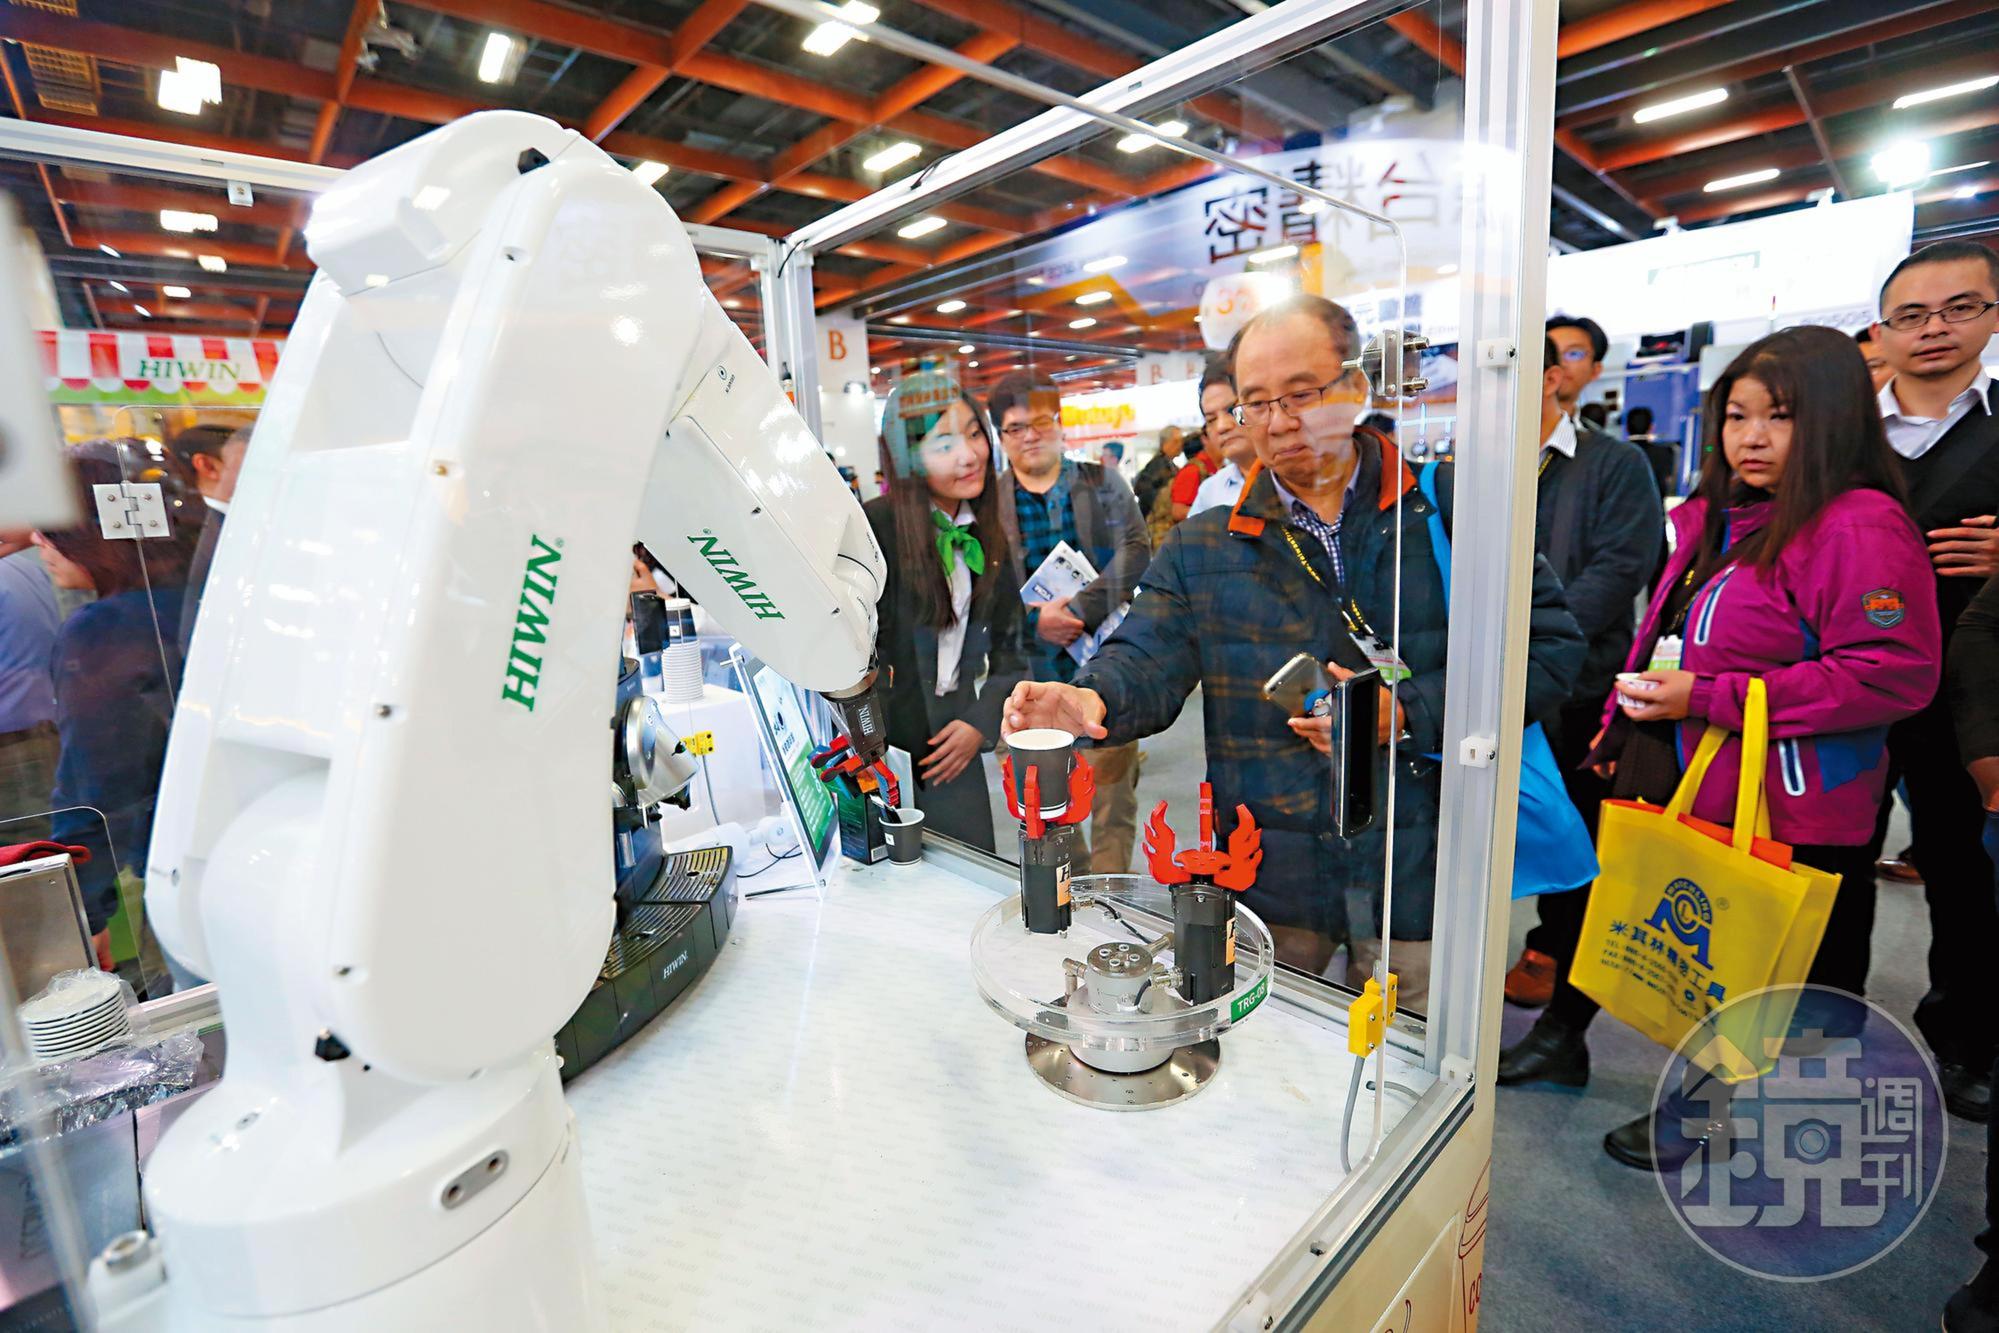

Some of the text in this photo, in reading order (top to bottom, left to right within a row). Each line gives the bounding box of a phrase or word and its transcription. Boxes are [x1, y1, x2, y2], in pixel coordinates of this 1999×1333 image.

[828, 329, 848, 361] B
[138, 359, 241, 380] HIWIN
[687, 535, 786, 620] HIWIN
[502, 534, 562, 712] HIWIN
[858, 706, 874, 736] HIWIN
[662, 949, 688, 980] HIWIN
